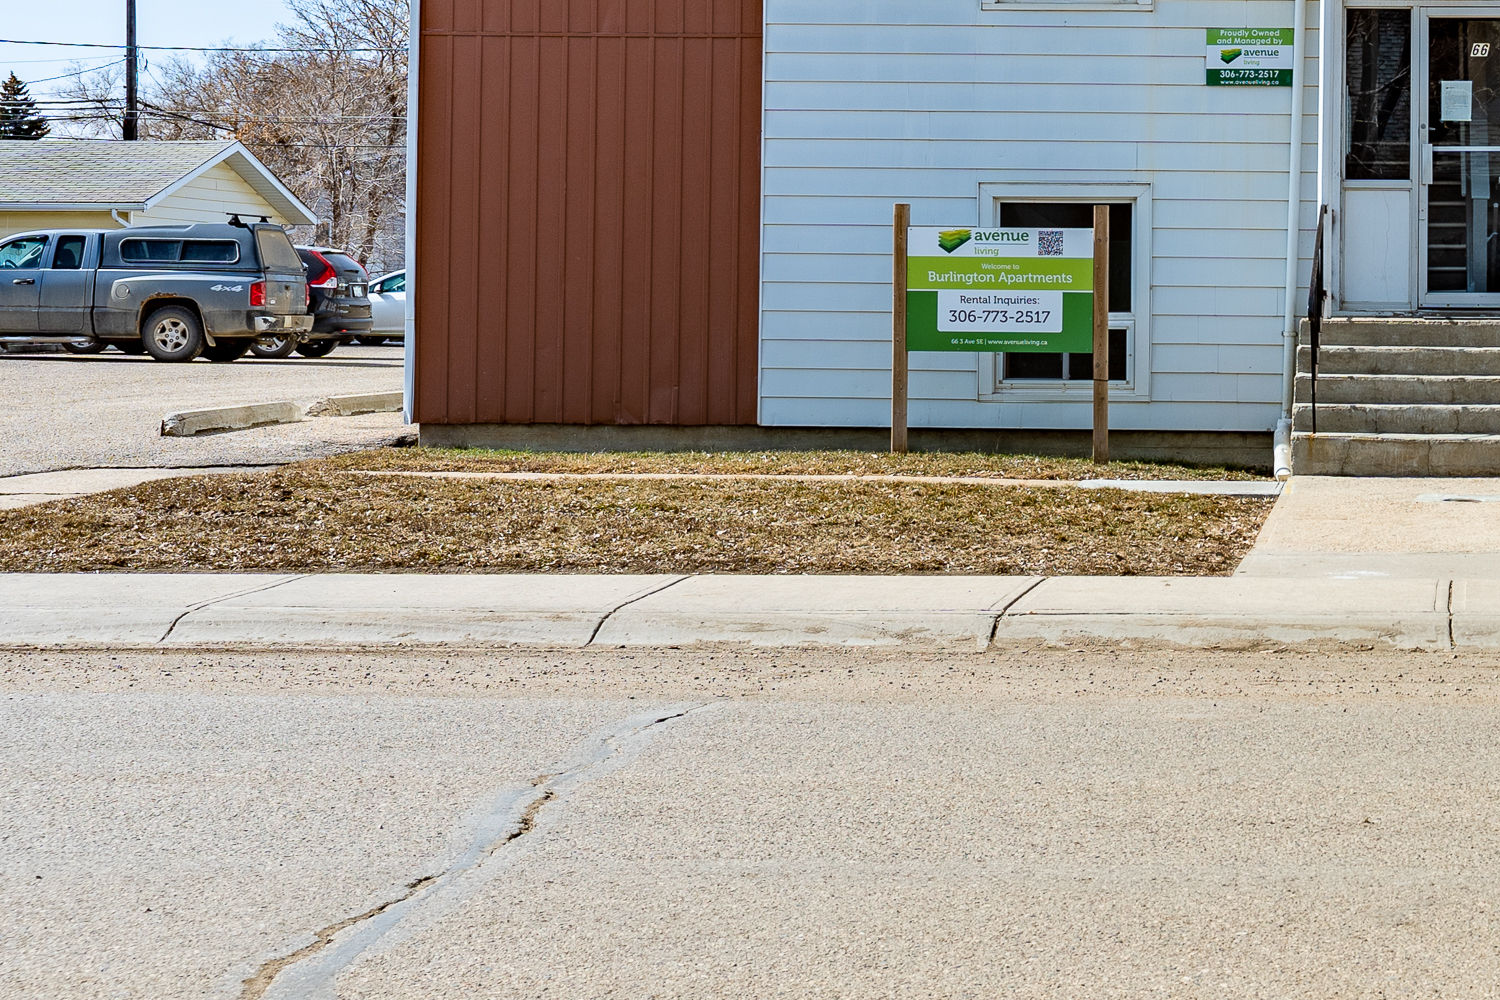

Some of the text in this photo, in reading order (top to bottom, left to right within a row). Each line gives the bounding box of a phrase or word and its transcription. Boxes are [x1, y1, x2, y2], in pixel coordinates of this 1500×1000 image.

[1220, 29, 1280, 38] Proudly Owned
[1233, 38, 1272, 46] Managed
[1273, 38, 1283, 46] by
[1473, 44, 1488, 55] 66
[1220, 70, 1279, 78] 306-773-2517
[974, 230, 1029, 242] avenue
[974, 247, 999, 256] living
[928, 271, 1073, 285] Burlington Apartments
[210, 284, 243, 293] 4x4
[960, 295, 1040, 306] Rental Inquiries:
[949, 310, 1050, 324] 306-773-2517
[988, 339, 1048, 347] www.avenueliving.ca
